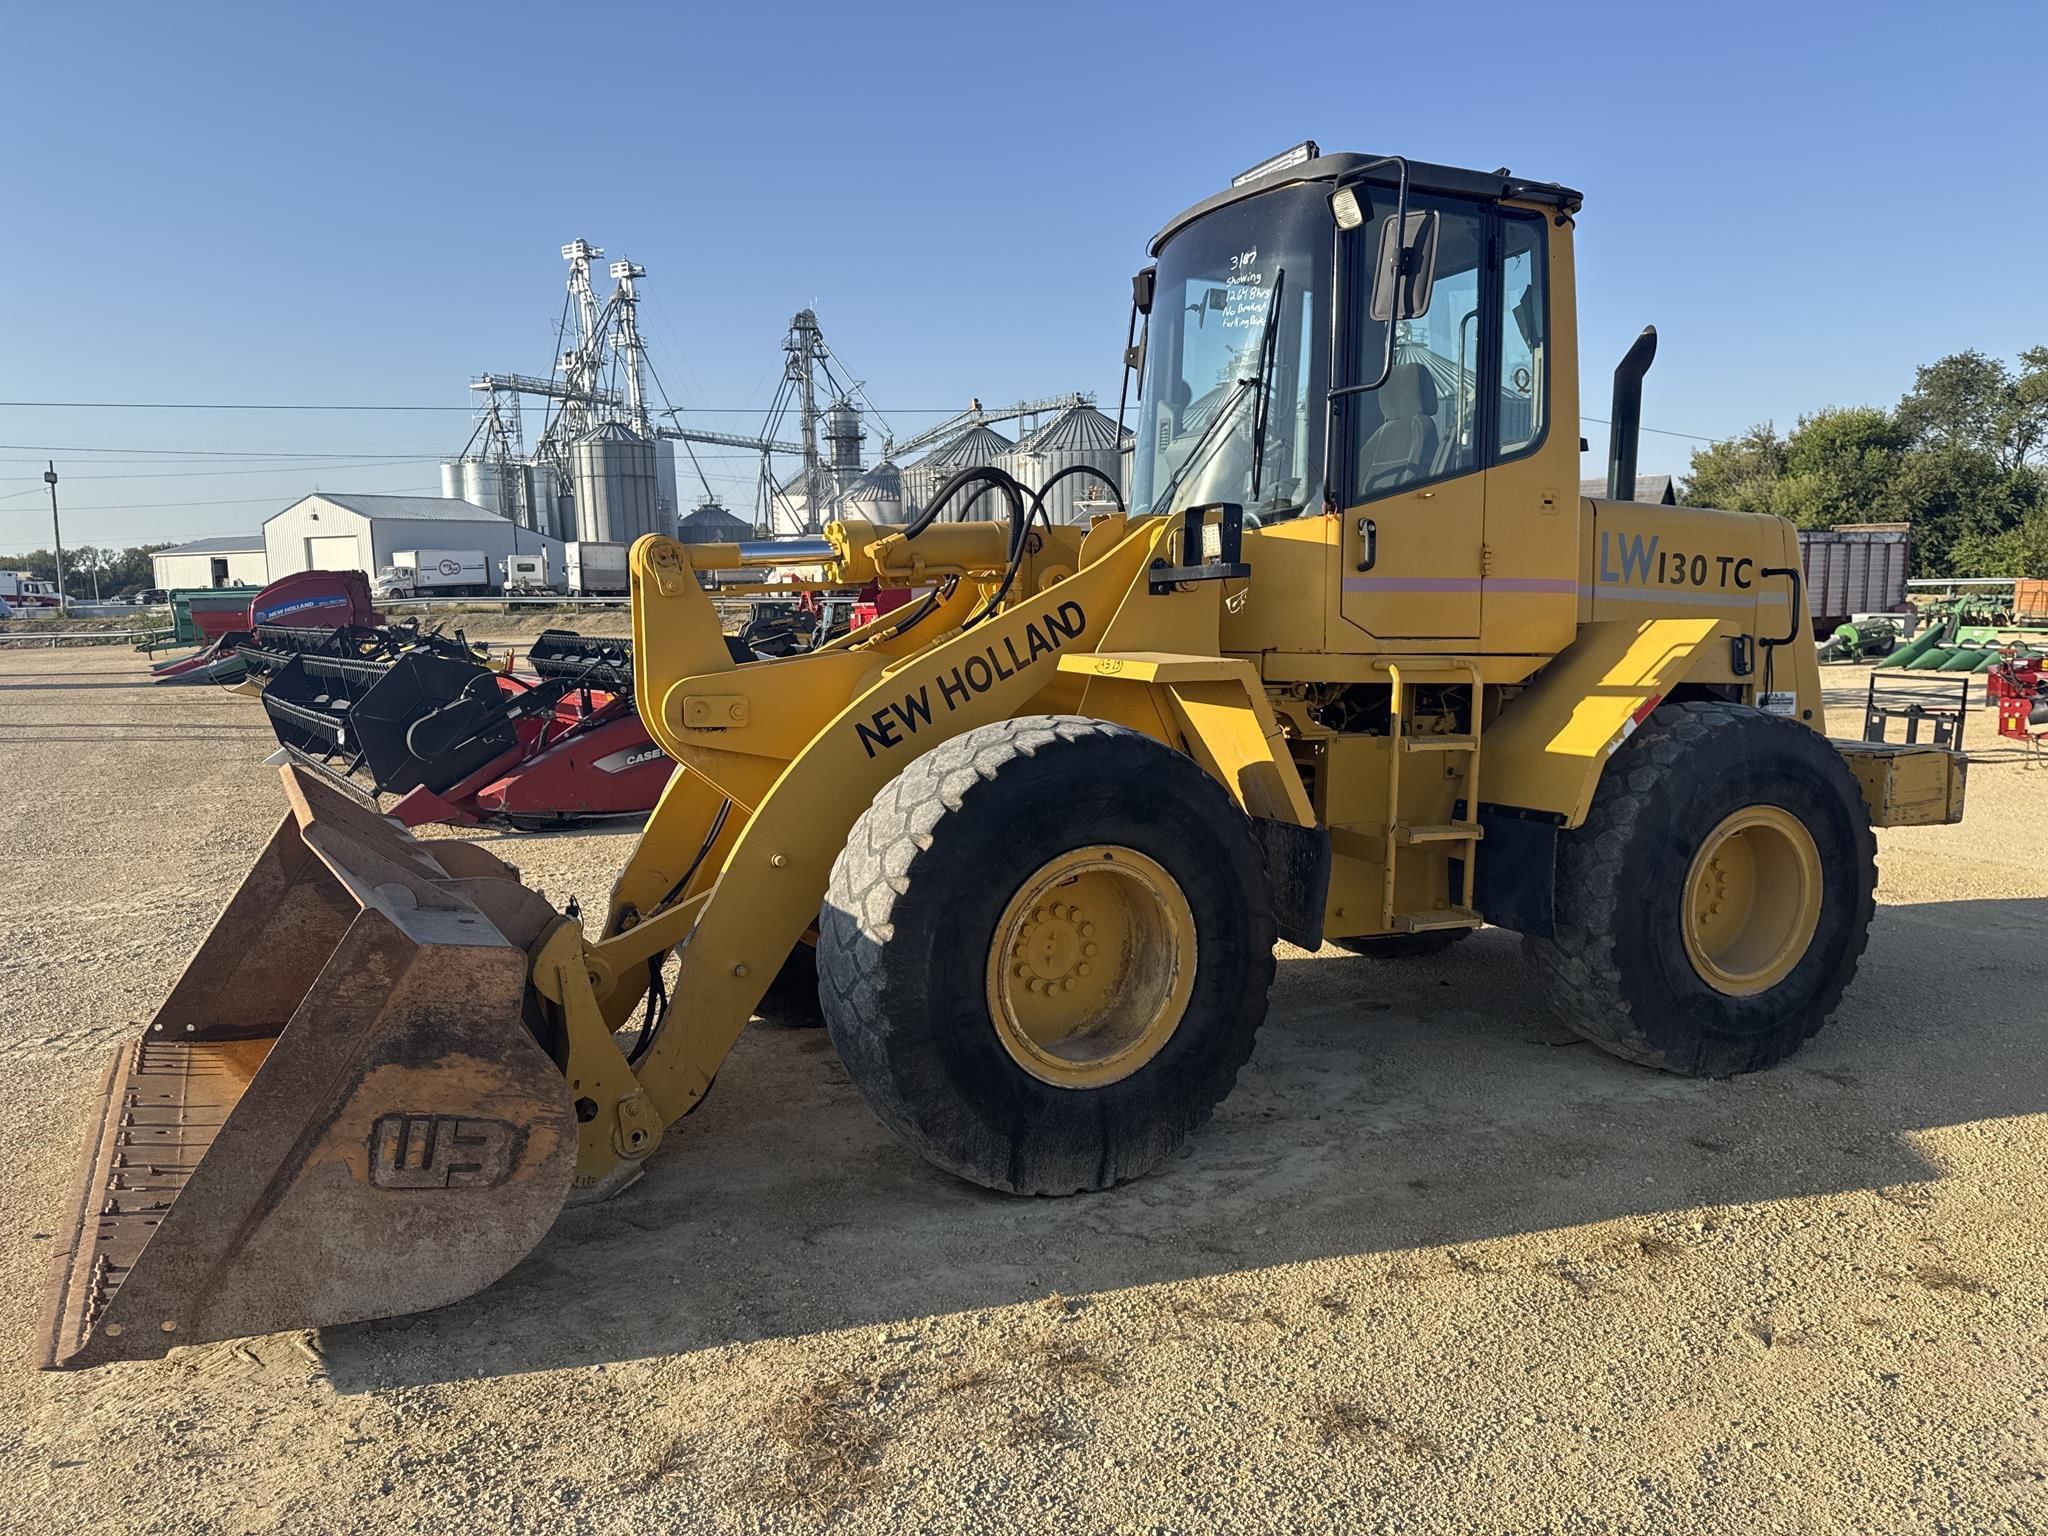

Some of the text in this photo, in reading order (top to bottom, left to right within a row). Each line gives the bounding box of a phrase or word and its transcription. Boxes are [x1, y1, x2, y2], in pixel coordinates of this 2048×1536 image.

[1222, 305, 1236, 317] No
[1716, 556, 1753, 589] TC
[268, 608, 284, 618] NEW
[284, 601, 315, 613] HOLLAND
[854, 600, 1087, 759] NEW HOLLAND
